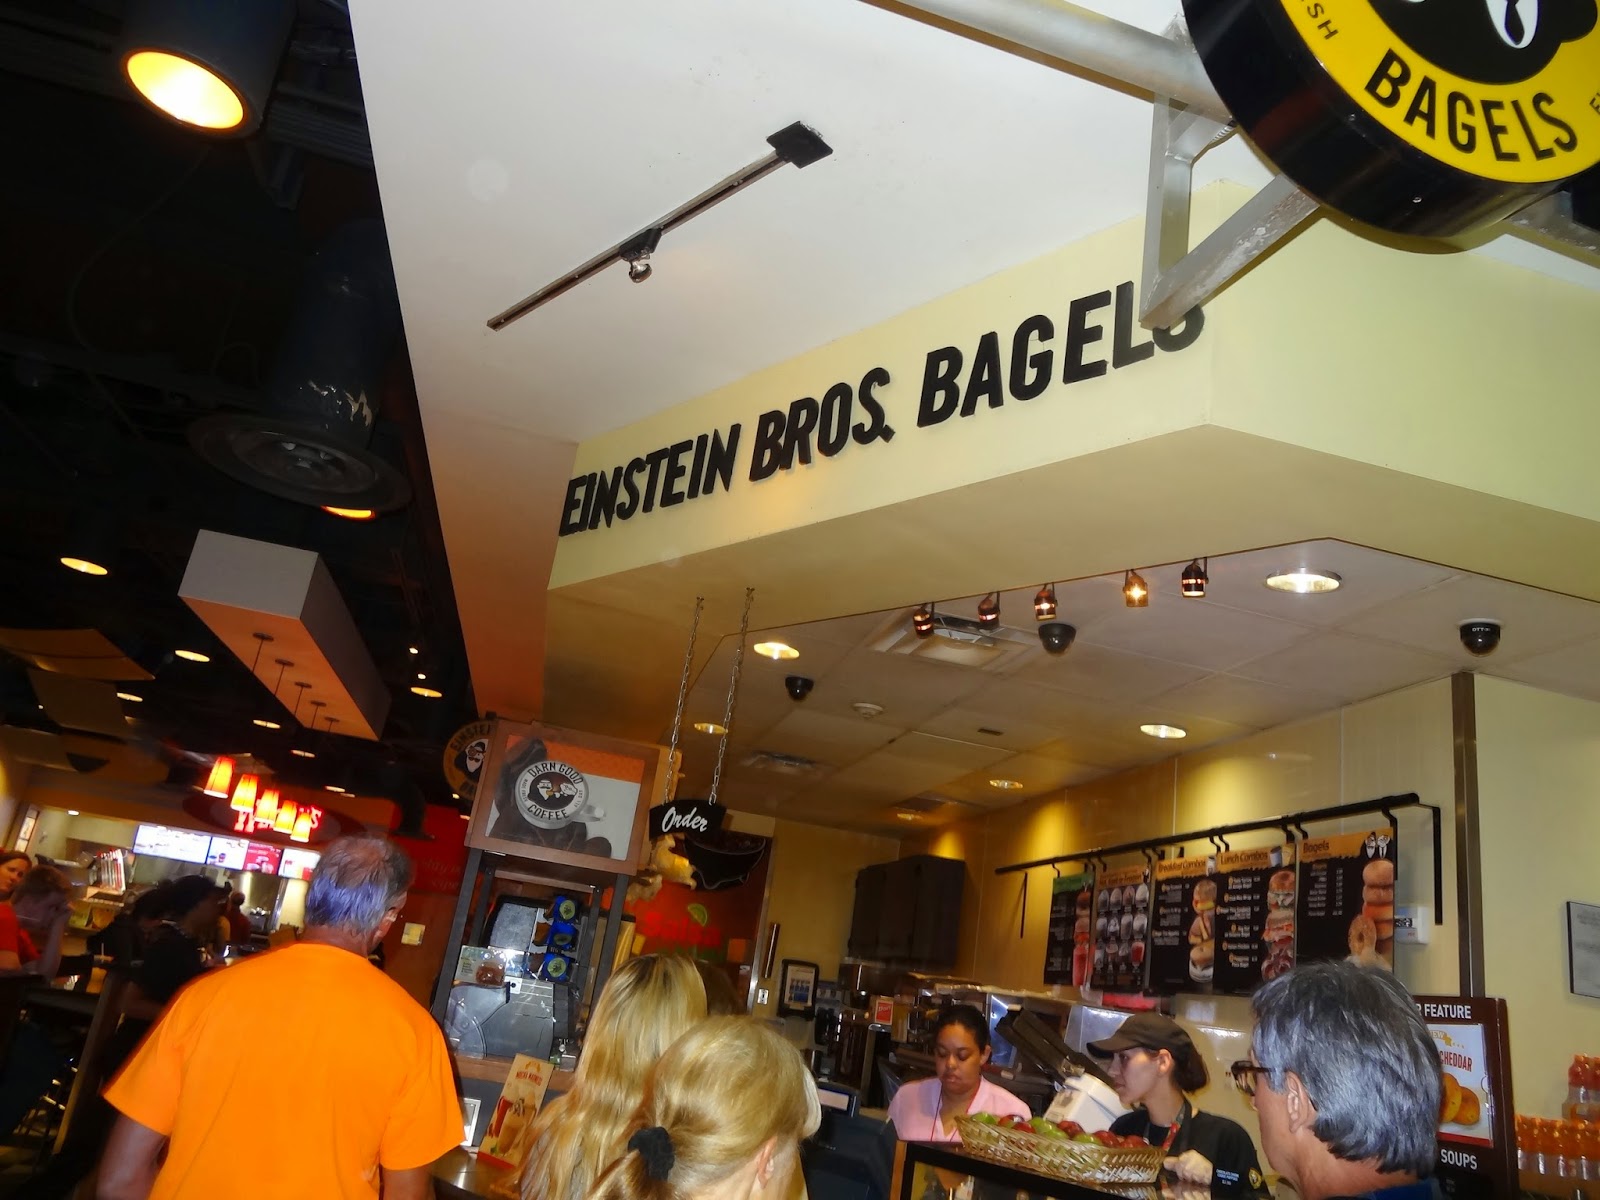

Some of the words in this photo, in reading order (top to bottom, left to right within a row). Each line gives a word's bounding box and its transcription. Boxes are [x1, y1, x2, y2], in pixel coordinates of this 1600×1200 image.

[1301, 0, 1340, 40] SH
[1364, 48, 1578, 163] BAGELS
[558, 422, 742, 537] EINSTEIN
[748, 367, 897, 483] BROS.
[527, 762, 556, 777] DARN
[558, 763, 584, 785] GOOD
[527, 804, 570, 821] COFFEE
[661, 806, 708, 833] Order
[1220, 852, 1239, 866] Lunch
[1239, 850, 1269, 863] Combos
[1303, 840, 1330, 853] Bagels
[1424, 1003, 1472, 1020] FEATURE
[1439, 1050, 1473, 1073] CHEDDAR
[1440, 1148, 1478, 1170] SOUPS
